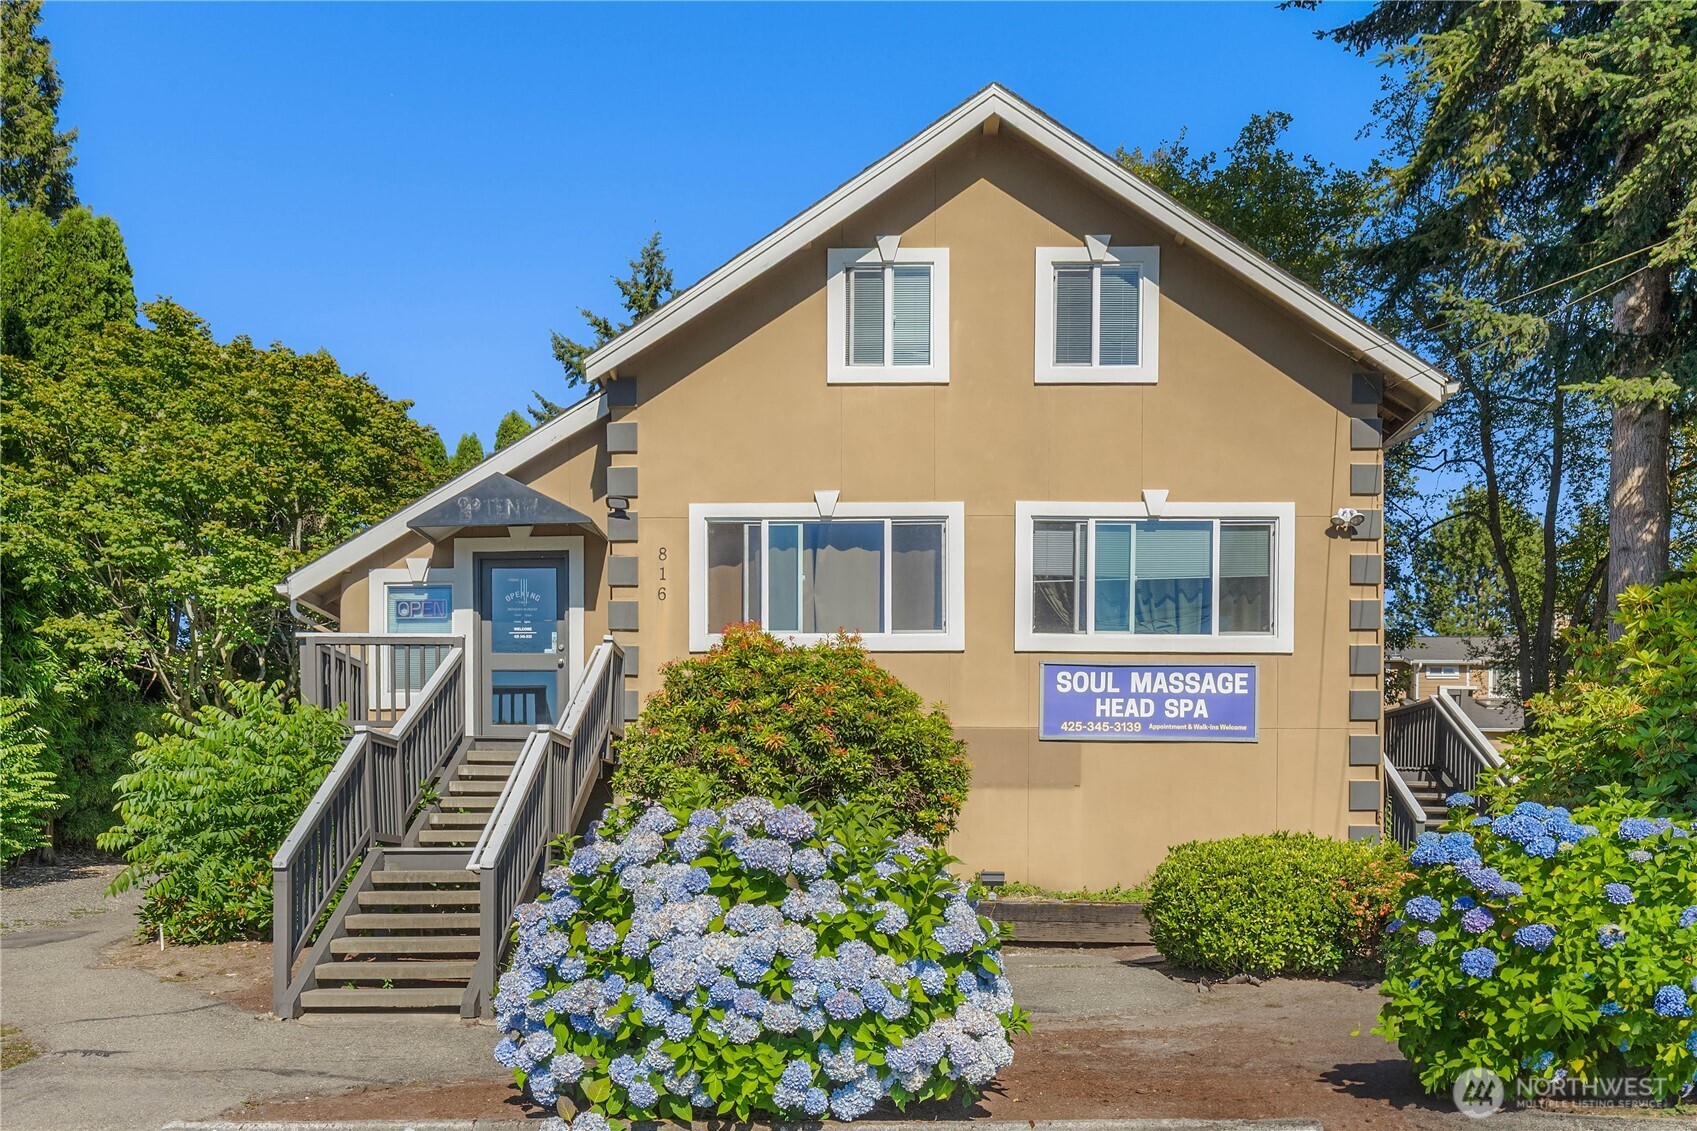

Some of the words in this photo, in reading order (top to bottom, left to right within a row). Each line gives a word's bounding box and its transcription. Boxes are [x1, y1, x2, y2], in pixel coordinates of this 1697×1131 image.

[658, 547, 667, 600] 816
[505, 584, 541, 603] OPENING
[398, 602, 444, 616] OPEN
[1056, 671, 1120, 693] SOUL
[1130, 672, 1248, 694] MASSAGE
[1096, 698, 1155, 718] HEAD
[1164, 699, 1208, 718] SPA
[1060, 722, 1142, 732] 425-345-3139
